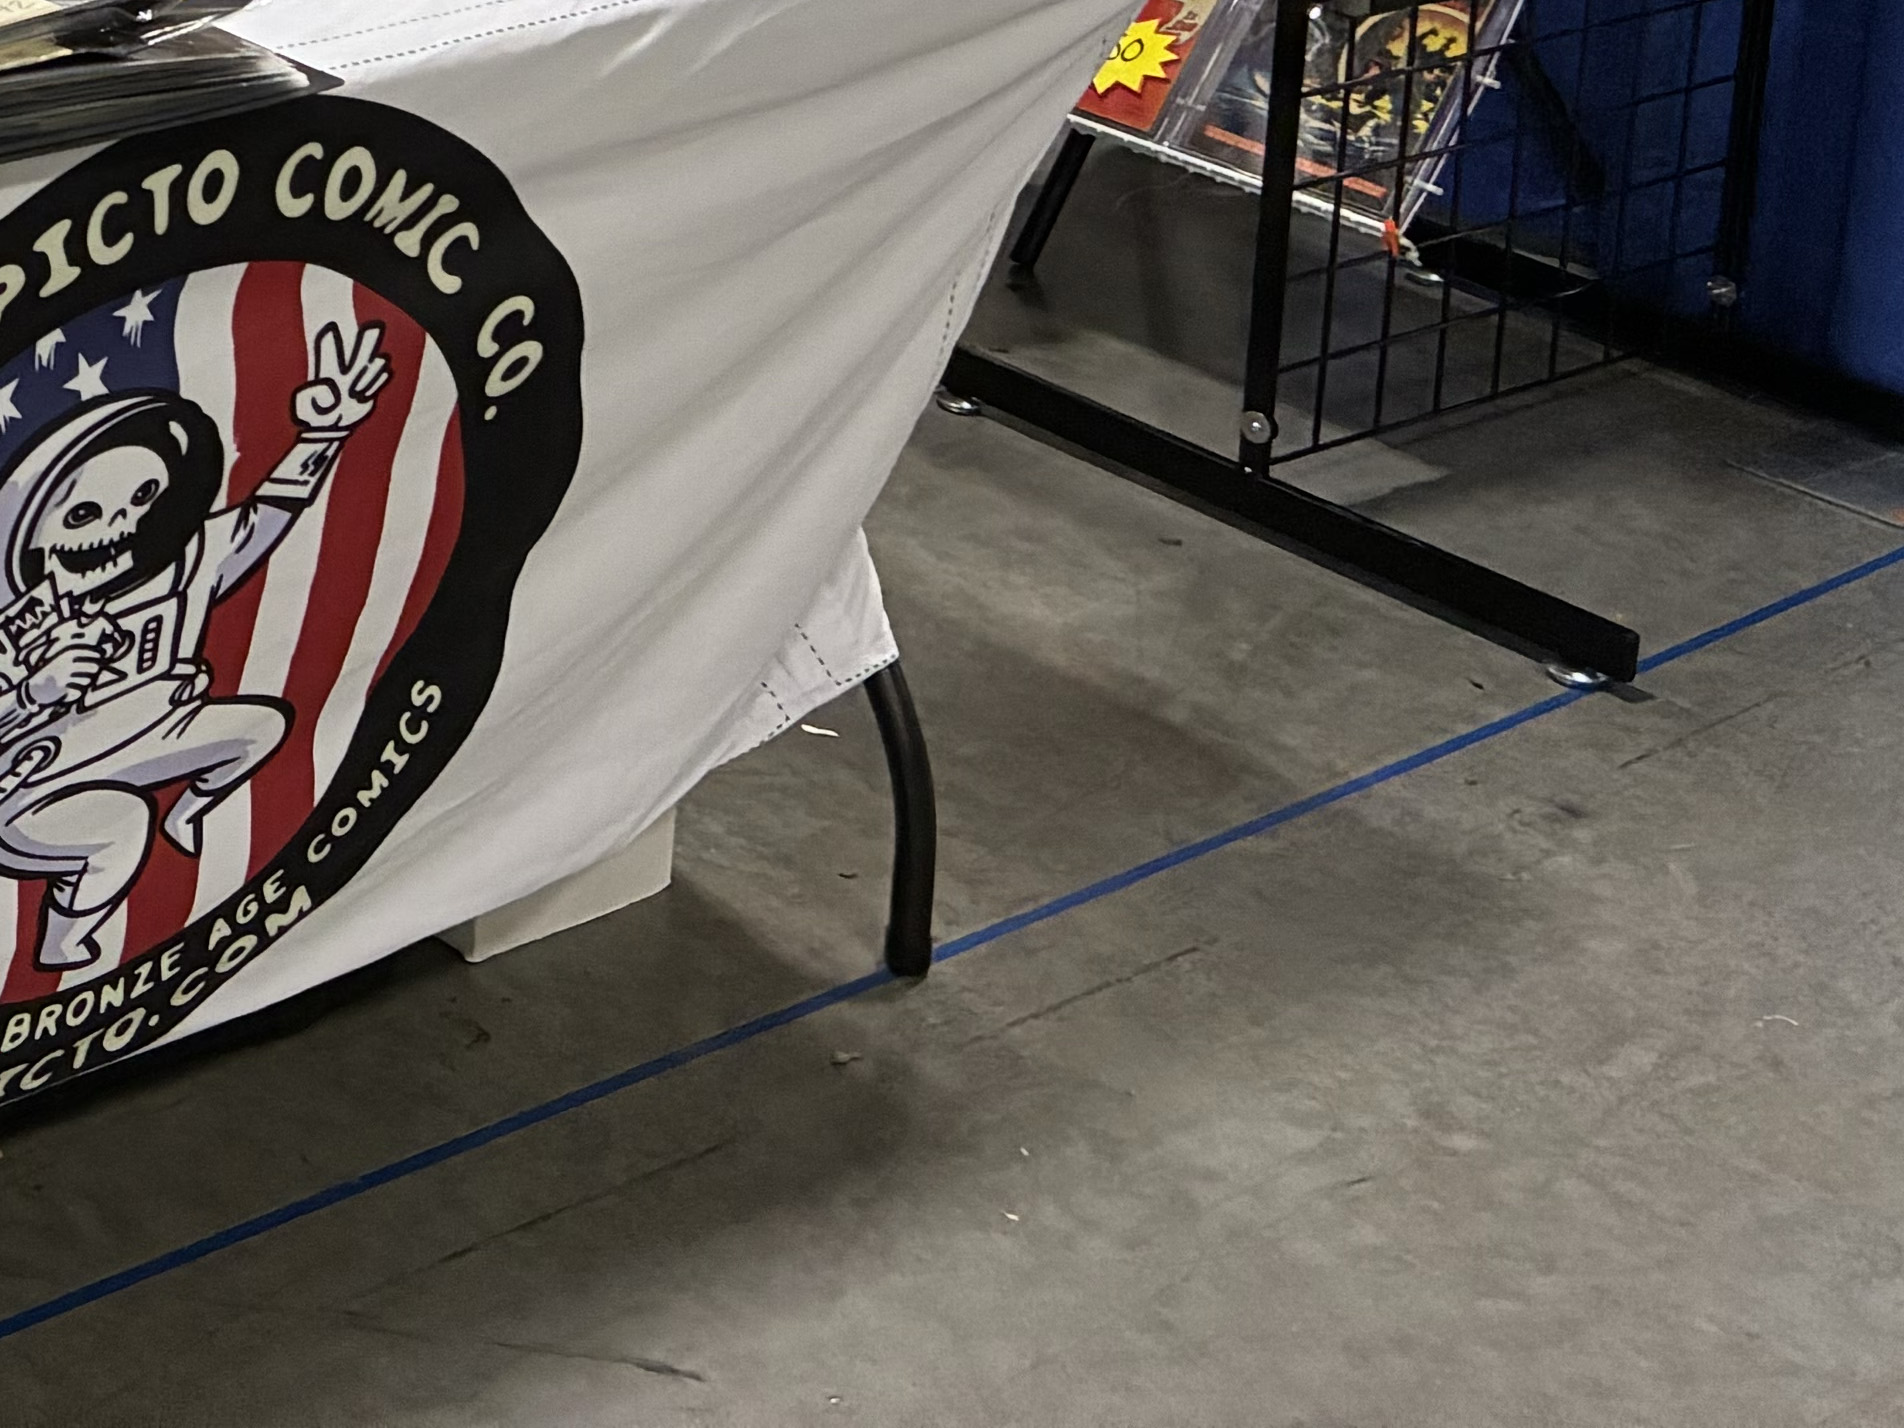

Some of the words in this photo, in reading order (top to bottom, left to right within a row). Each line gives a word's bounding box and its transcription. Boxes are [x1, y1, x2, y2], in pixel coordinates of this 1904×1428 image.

[274, 142, 482, 297] COMIC
[476, 295, 544, 422] CO.
[0, 944, 187, 1052] BRONZE
[205, 869, 289, 952] AGE
[305, 675, 446, 868] COMICS
